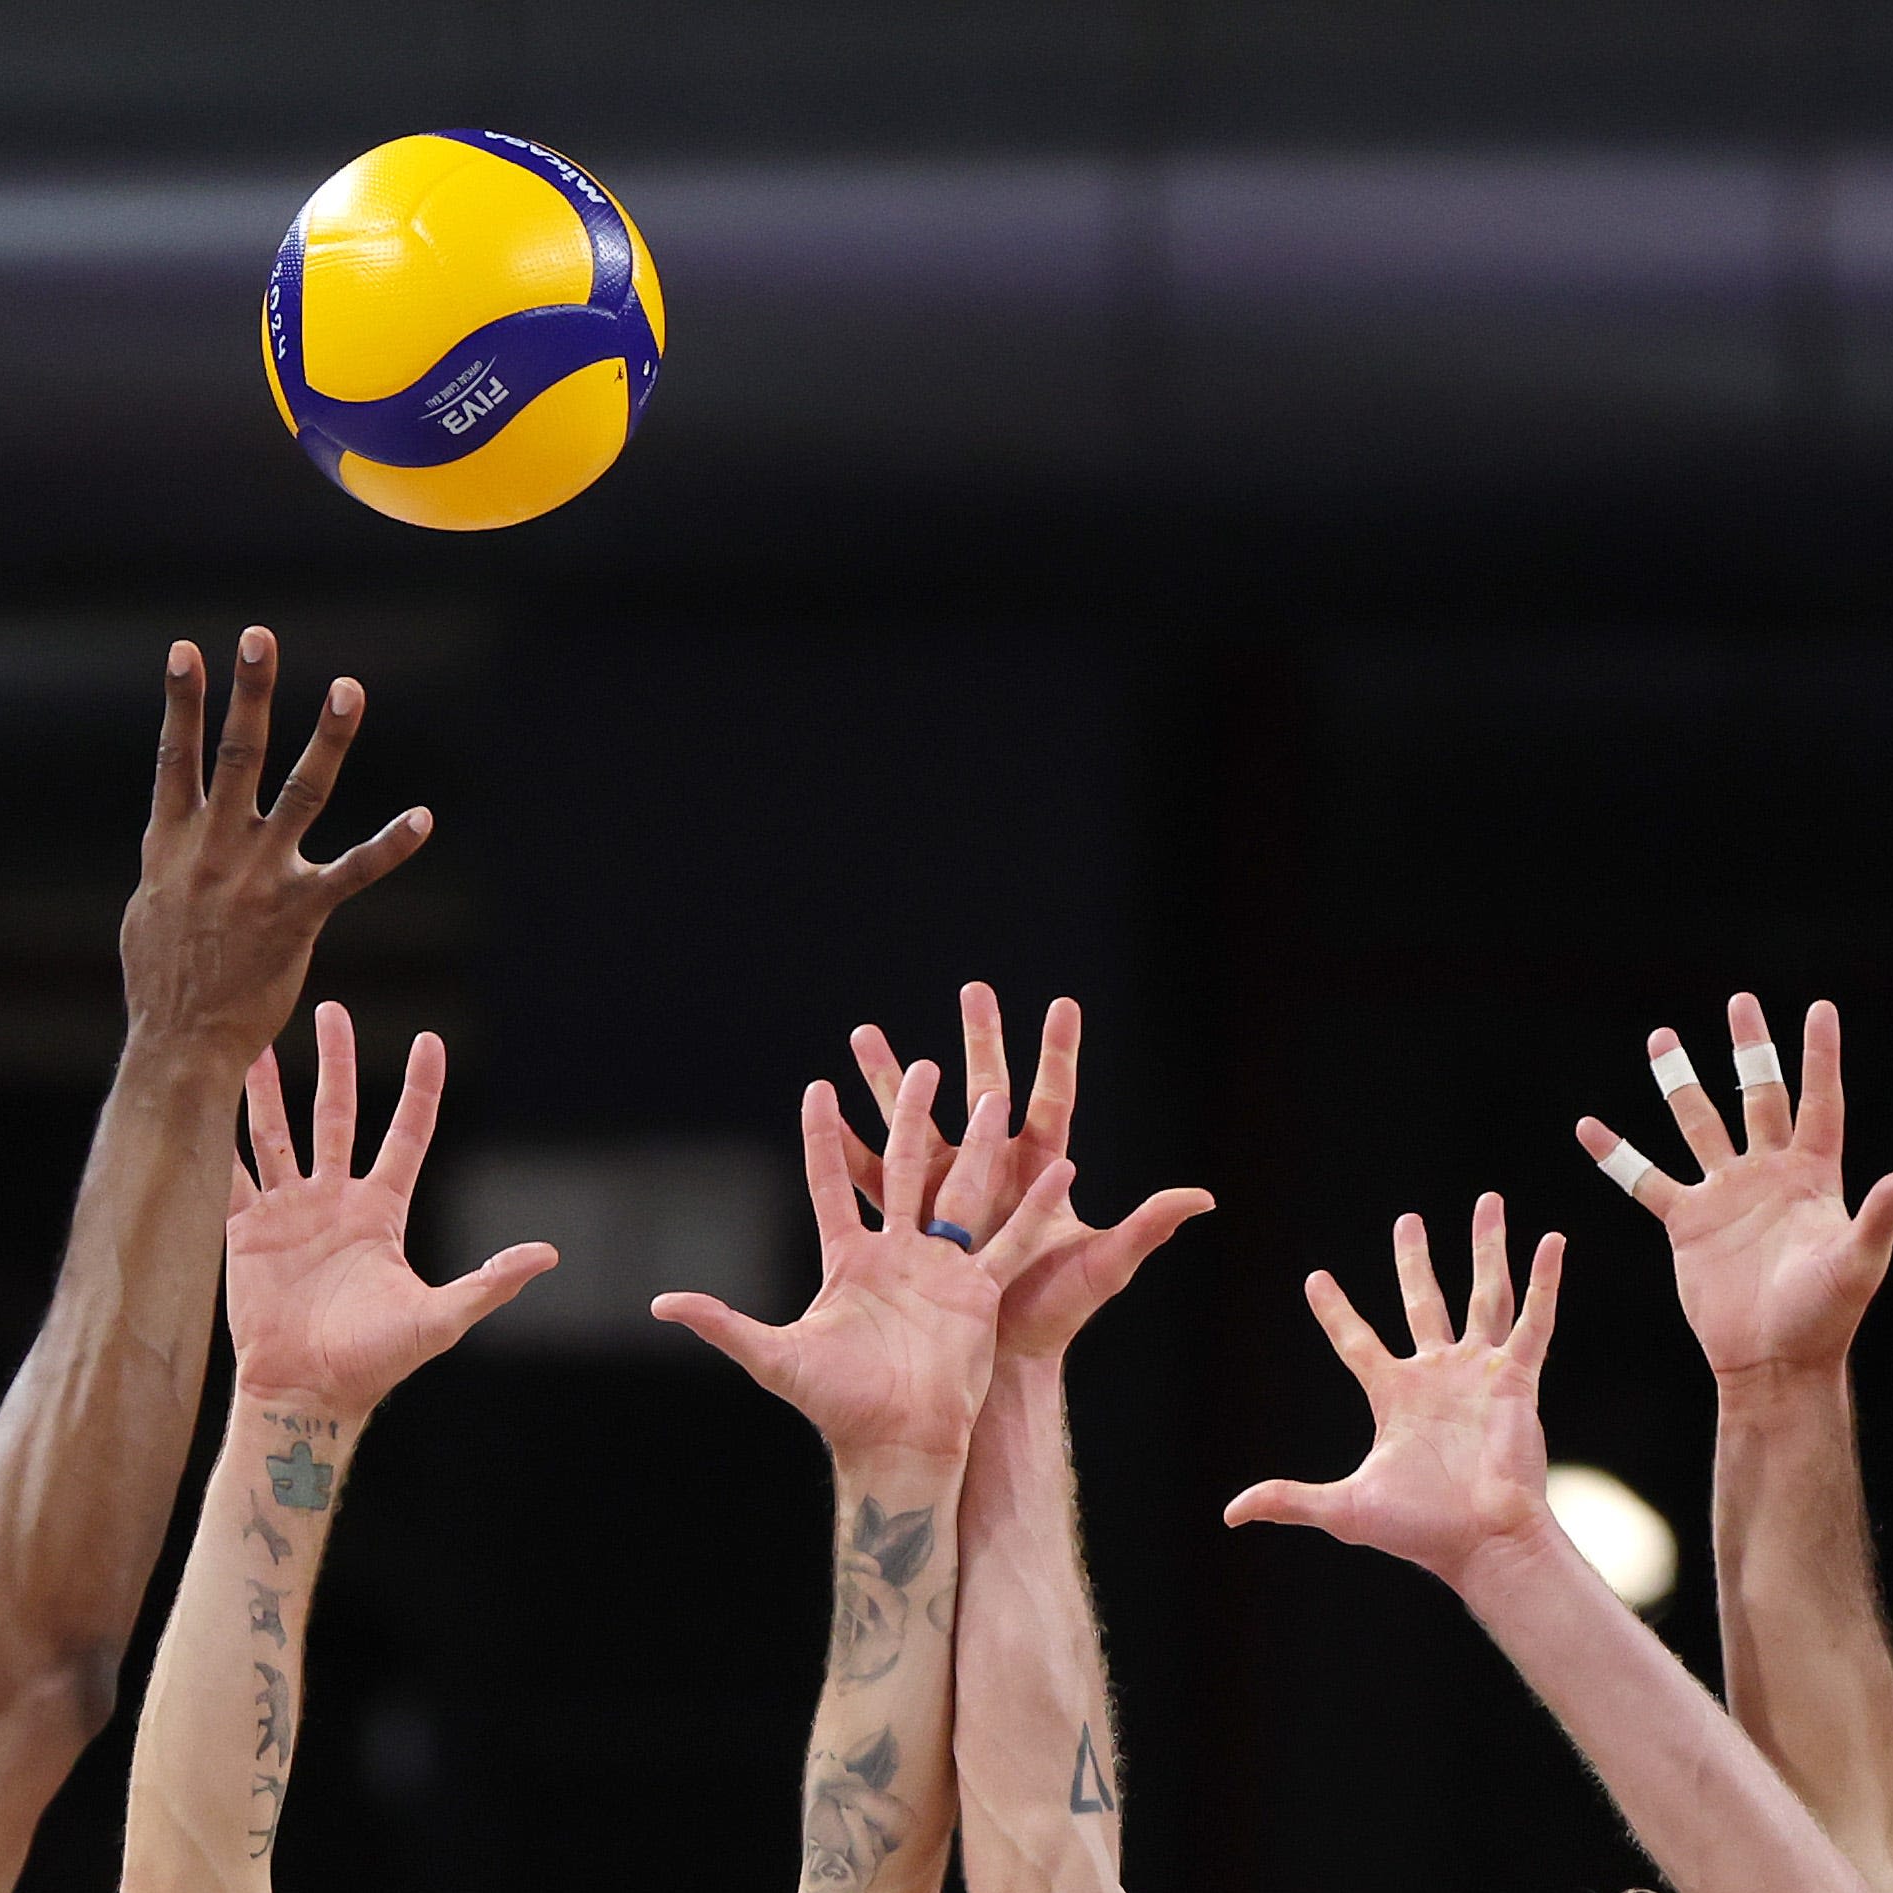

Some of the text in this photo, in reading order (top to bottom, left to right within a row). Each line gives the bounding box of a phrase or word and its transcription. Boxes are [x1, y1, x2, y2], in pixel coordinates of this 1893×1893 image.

[438, 381, 461, 401] GAME
[424, 394, 444, 409] BALL
[442, 376, 509, 434] FIVB
